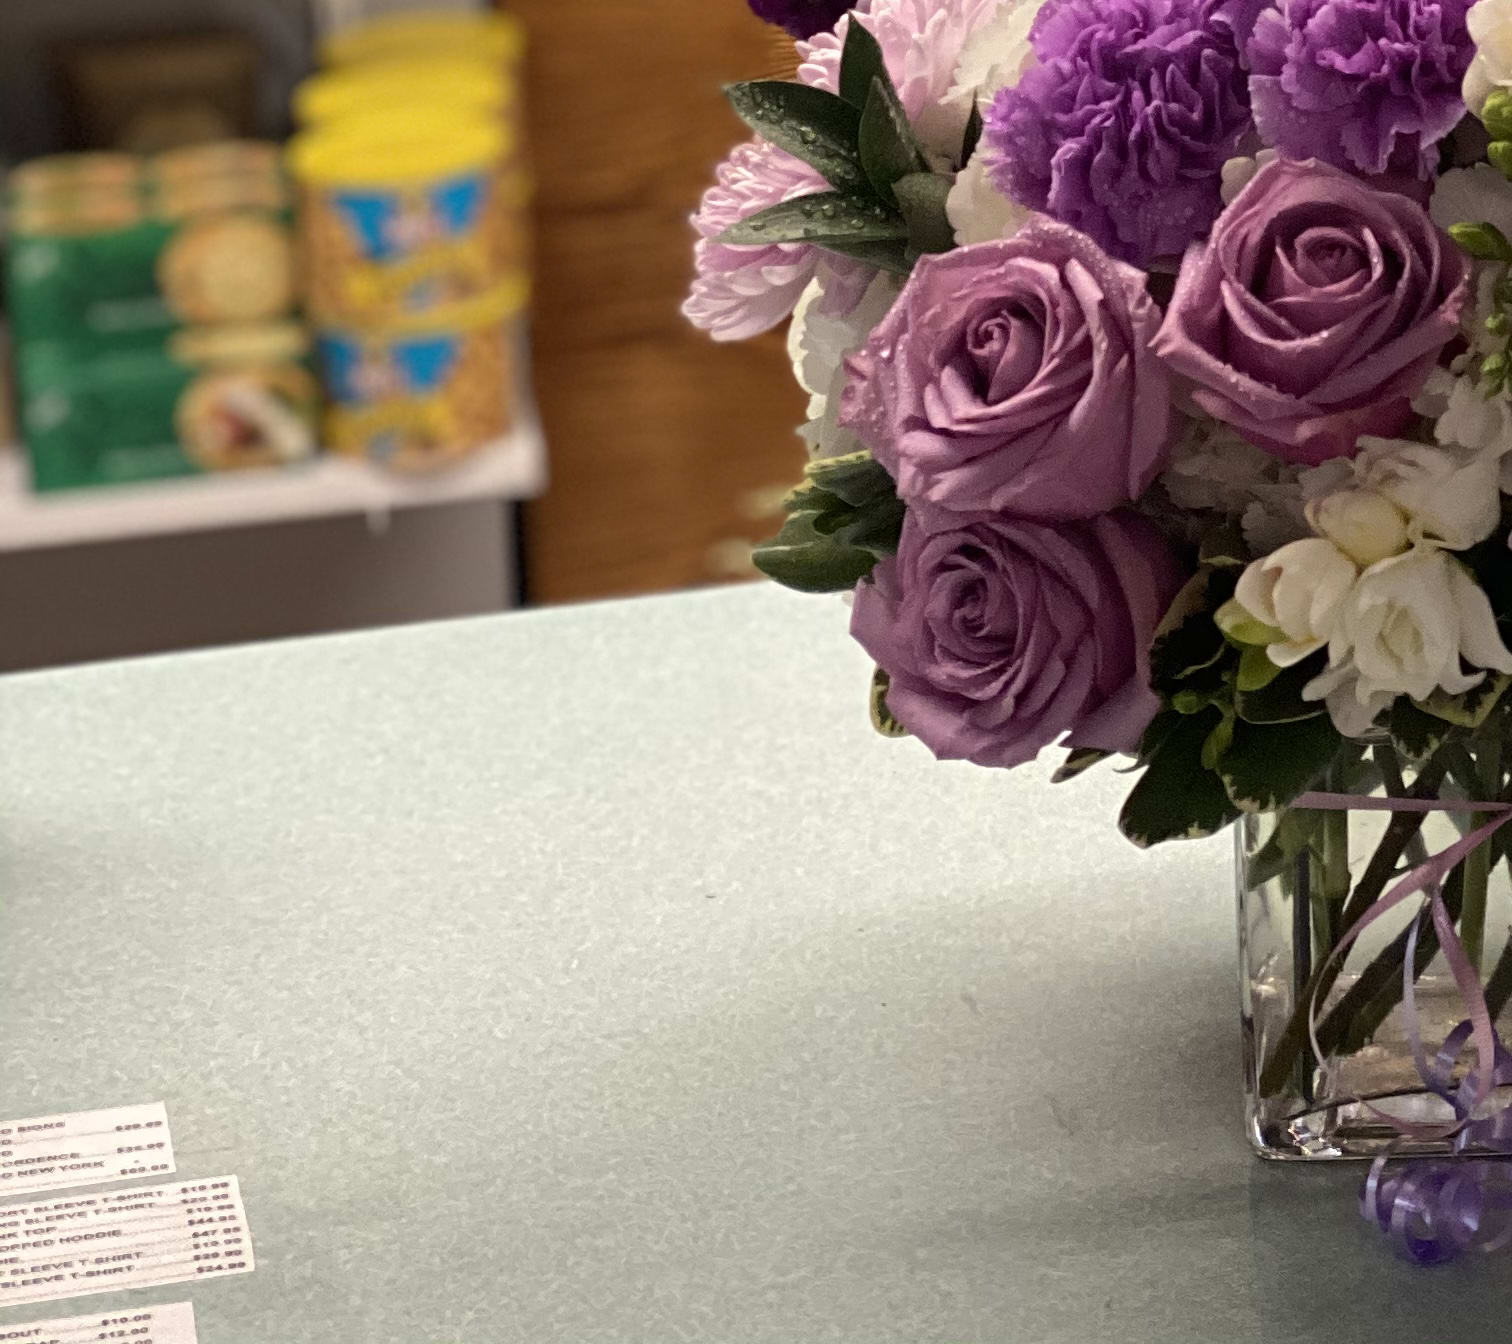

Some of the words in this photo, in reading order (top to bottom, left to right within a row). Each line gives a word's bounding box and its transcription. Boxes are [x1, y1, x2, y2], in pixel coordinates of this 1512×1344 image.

[17, 1166, 55, 1177] NEW
[58, 1160, 105, 1172] YORK
[33, 1199, 97, 1213] SLEEVE
[25, 1211, 88, 1225] SLEEVE
[23, 1226, 57, 1237] TOP
[10, 1261, 73, 1276] SLEEVE
